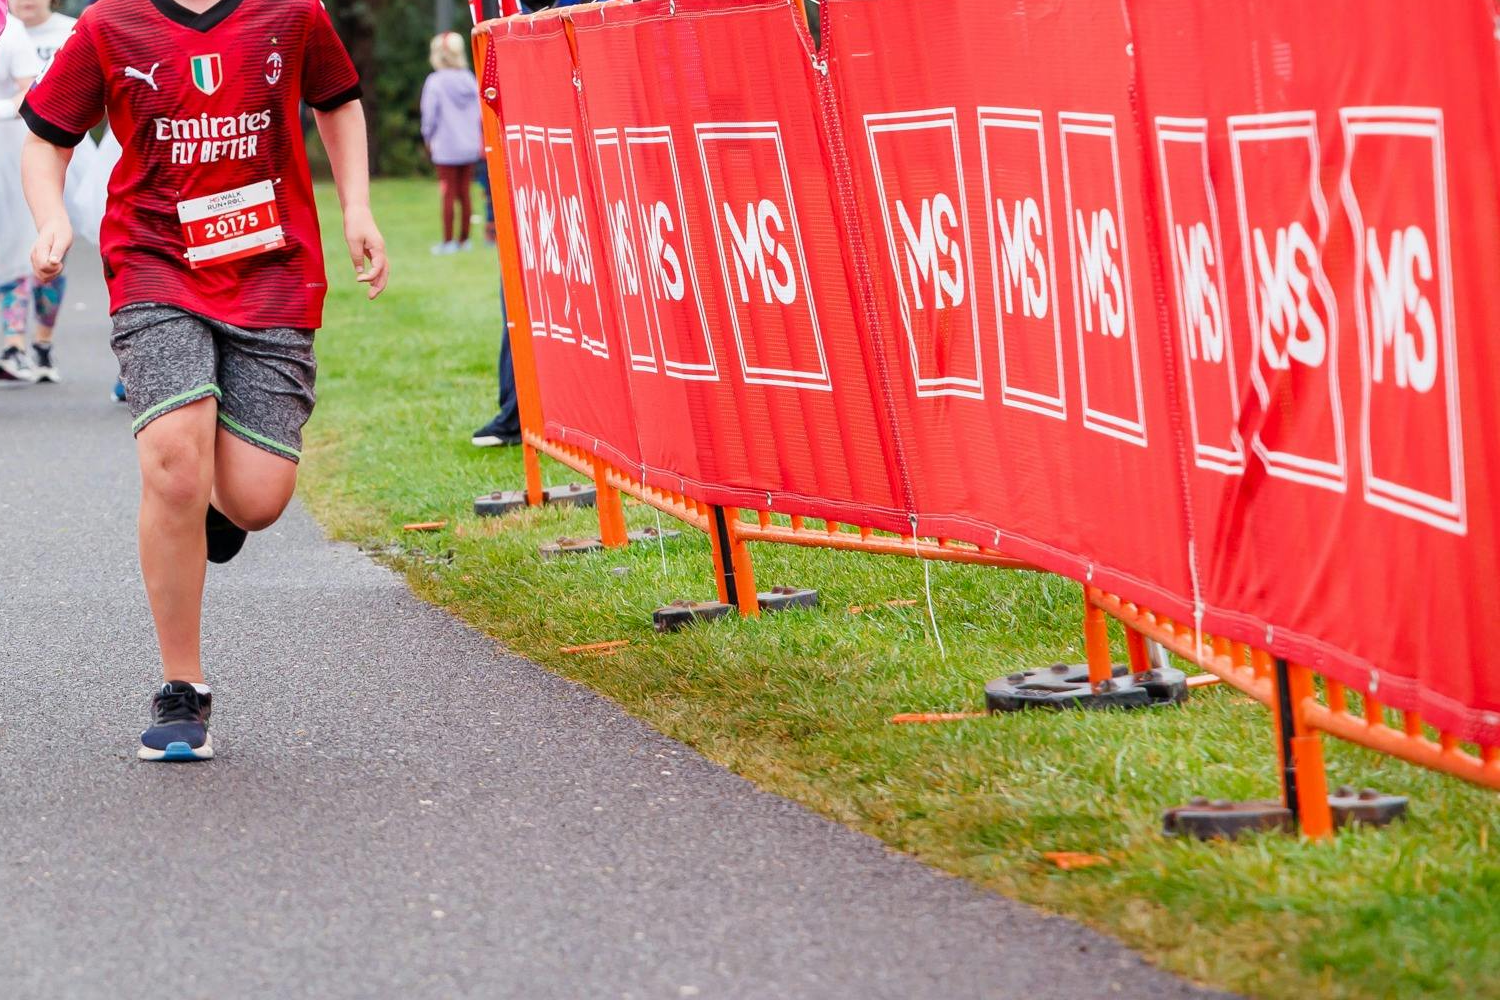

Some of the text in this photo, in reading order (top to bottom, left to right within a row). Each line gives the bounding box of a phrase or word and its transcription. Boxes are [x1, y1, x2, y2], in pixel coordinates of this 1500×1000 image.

[153, 109, 271, 140] Emirates
[171, 135, 258, 164] FLY BETTER
[204, 211, 259, 239] 20175
[562, 194, 591, 286] MS
[608, 199, 639, 296] MS
[641, 201, 684, 301] MS
[723, 199, 797, 305] MS
[896, 193, 965, 310] MS
[997, 197, 1048, 319] MS
[1076, 208, 1126, 339] MS
[1176, 222, 1224, 363] MS
[1253, 221, 1326, 370] MS
[1366, 224, 1438, 393] MS
